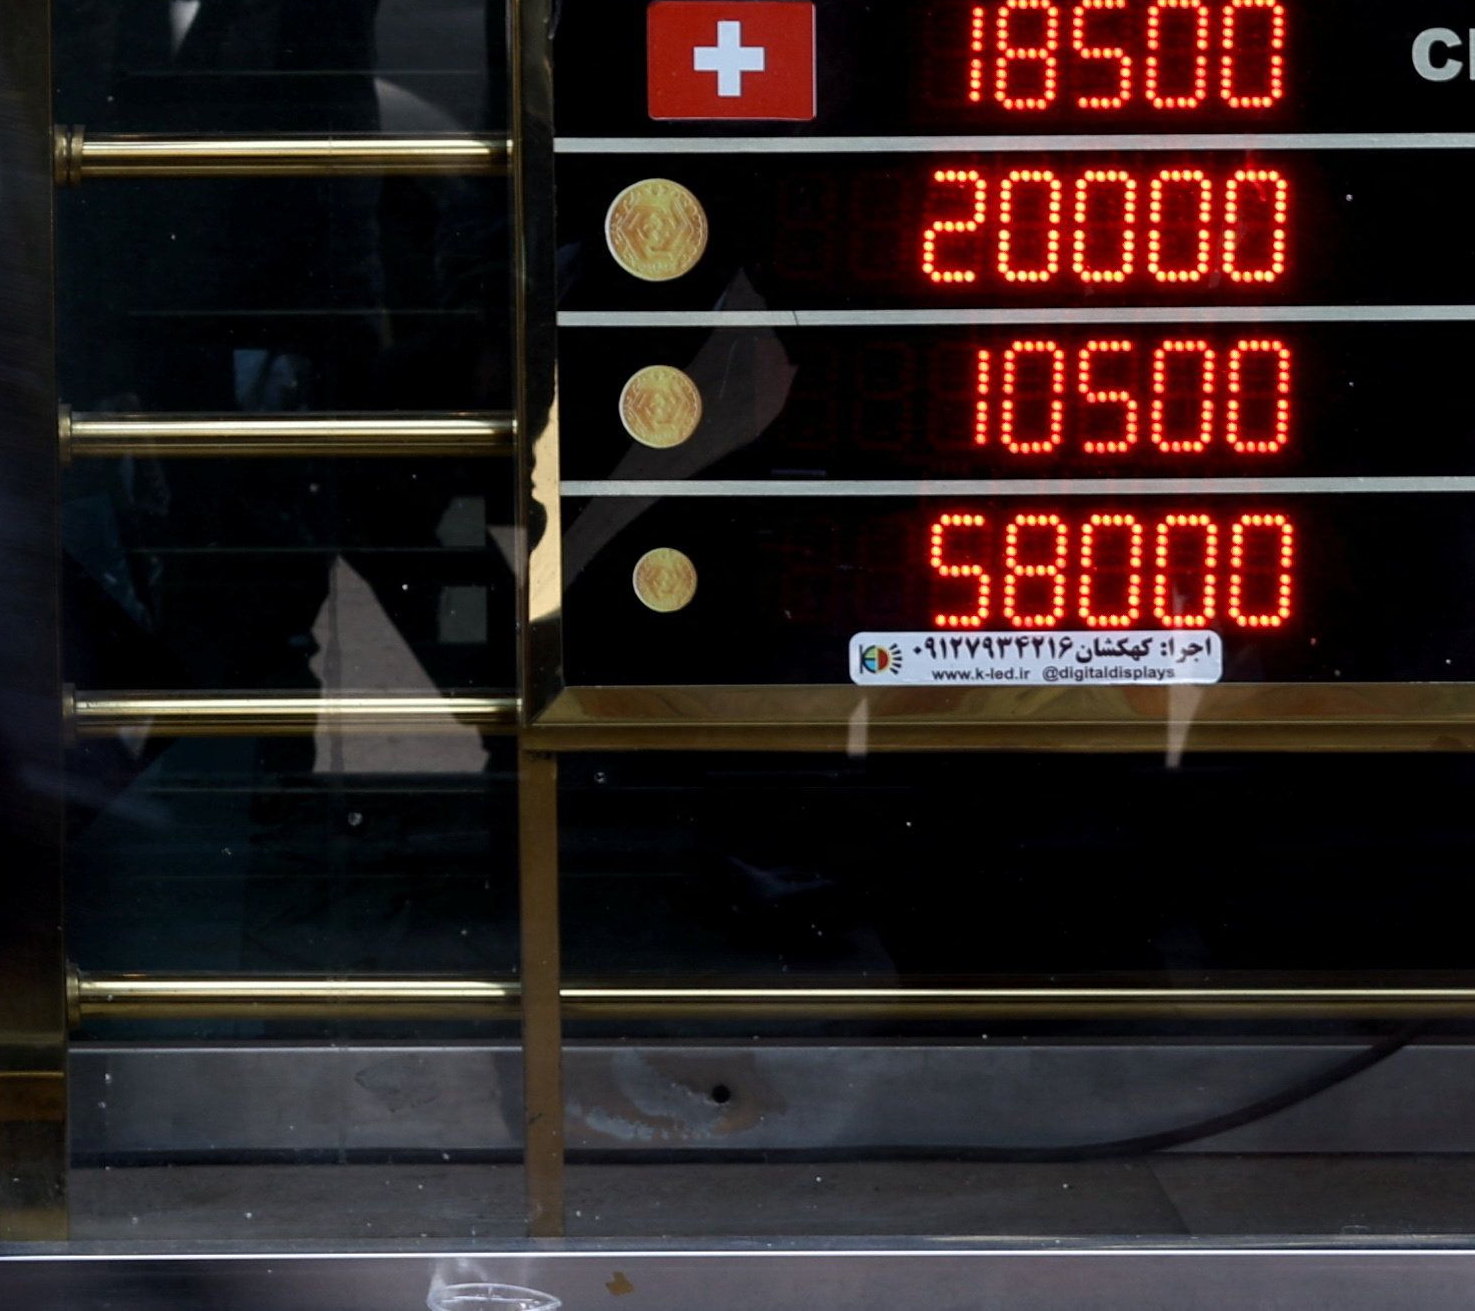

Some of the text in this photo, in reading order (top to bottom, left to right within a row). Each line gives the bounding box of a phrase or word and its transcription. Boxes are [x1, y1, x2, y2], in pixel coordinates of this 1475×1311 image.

[920, 167, 1289, 285] 20000
[973, 338, 1293, 456] 10500
[928, 512, 1295, 630] 58000
[931, 665, 1176, 683] www.k-led.ir @digitaldisplays
[1074, 635, 1152, 664] کهکشان
